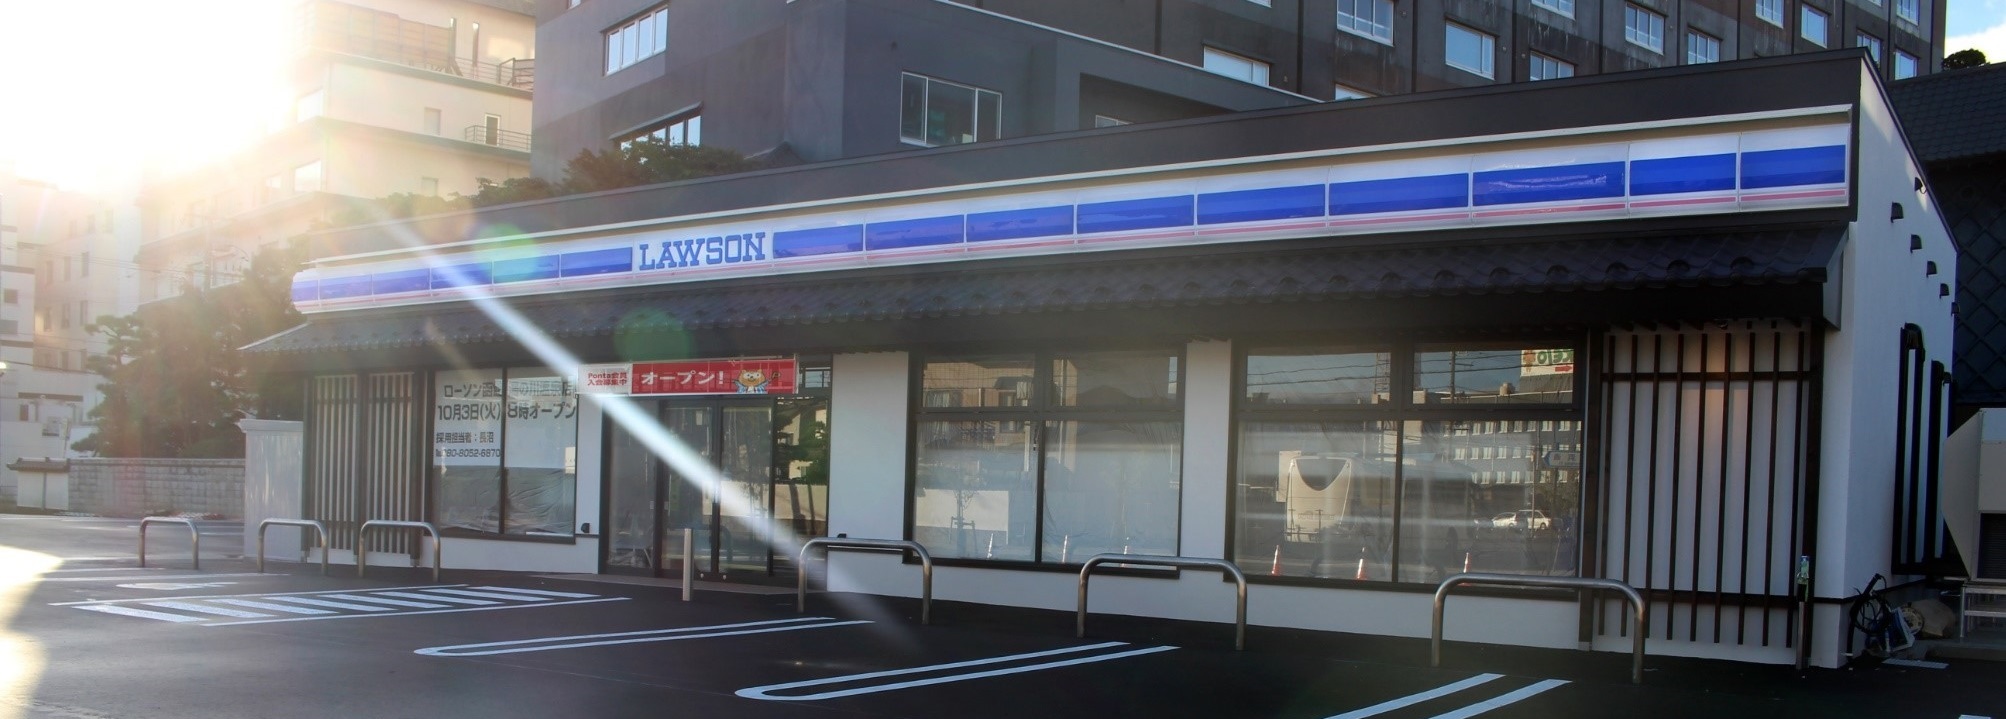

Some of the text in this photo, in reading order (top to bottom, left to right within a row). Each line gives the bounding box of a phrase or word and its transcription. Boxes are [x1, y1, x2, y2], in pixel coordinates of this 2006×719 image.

[639, 232, 765, 271] LAWSON
[588, 371, 627, 379] Ponta会員
[641, 369, 724, 386] オープン！
[587, 378, 627, 386] 入会募集中
